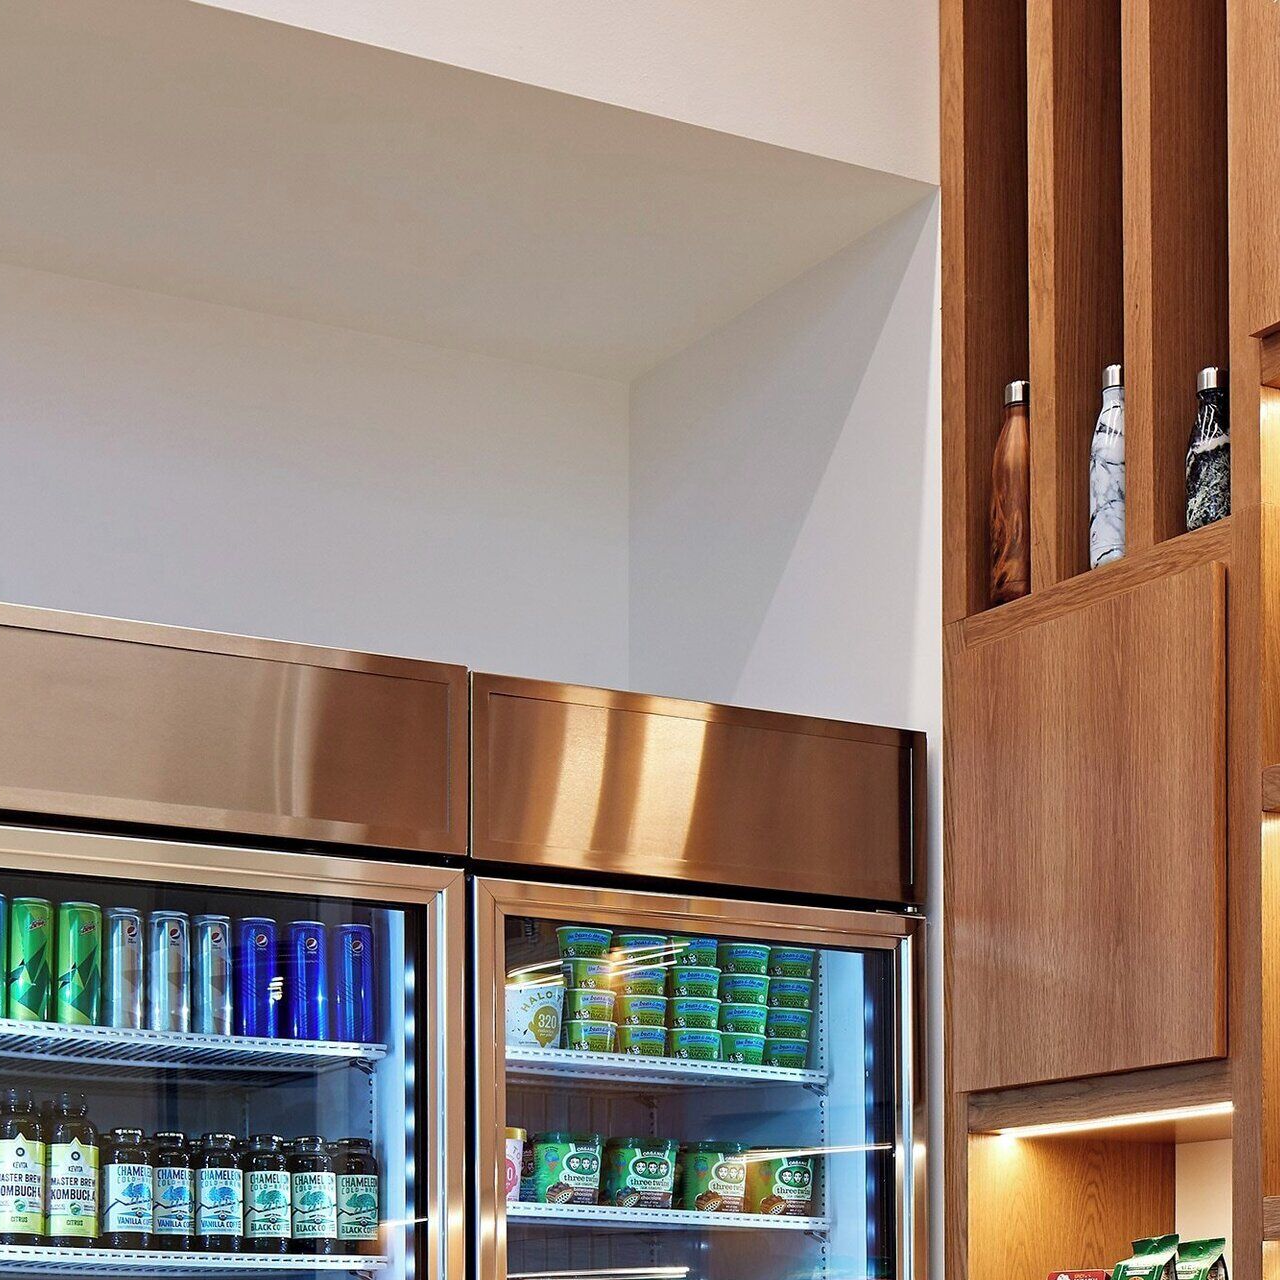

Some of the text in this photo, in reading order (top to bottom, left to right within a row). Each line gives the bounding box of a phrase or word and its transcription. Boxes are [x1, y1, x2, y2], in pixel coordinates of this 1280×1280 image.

[538, 1014, 556, 1028] 320
[564, 1174, 585, 1182] three
[630, 1178, 650, 1187] three
[712, 1182, 731, 1191] three
[776, 1187, 795, 1195] three
[201, 1220, 224, 1228] VANILLA
[296, 1224, 316, 1232] BLACK
[341, 1226, 362, 1234] BLACK
